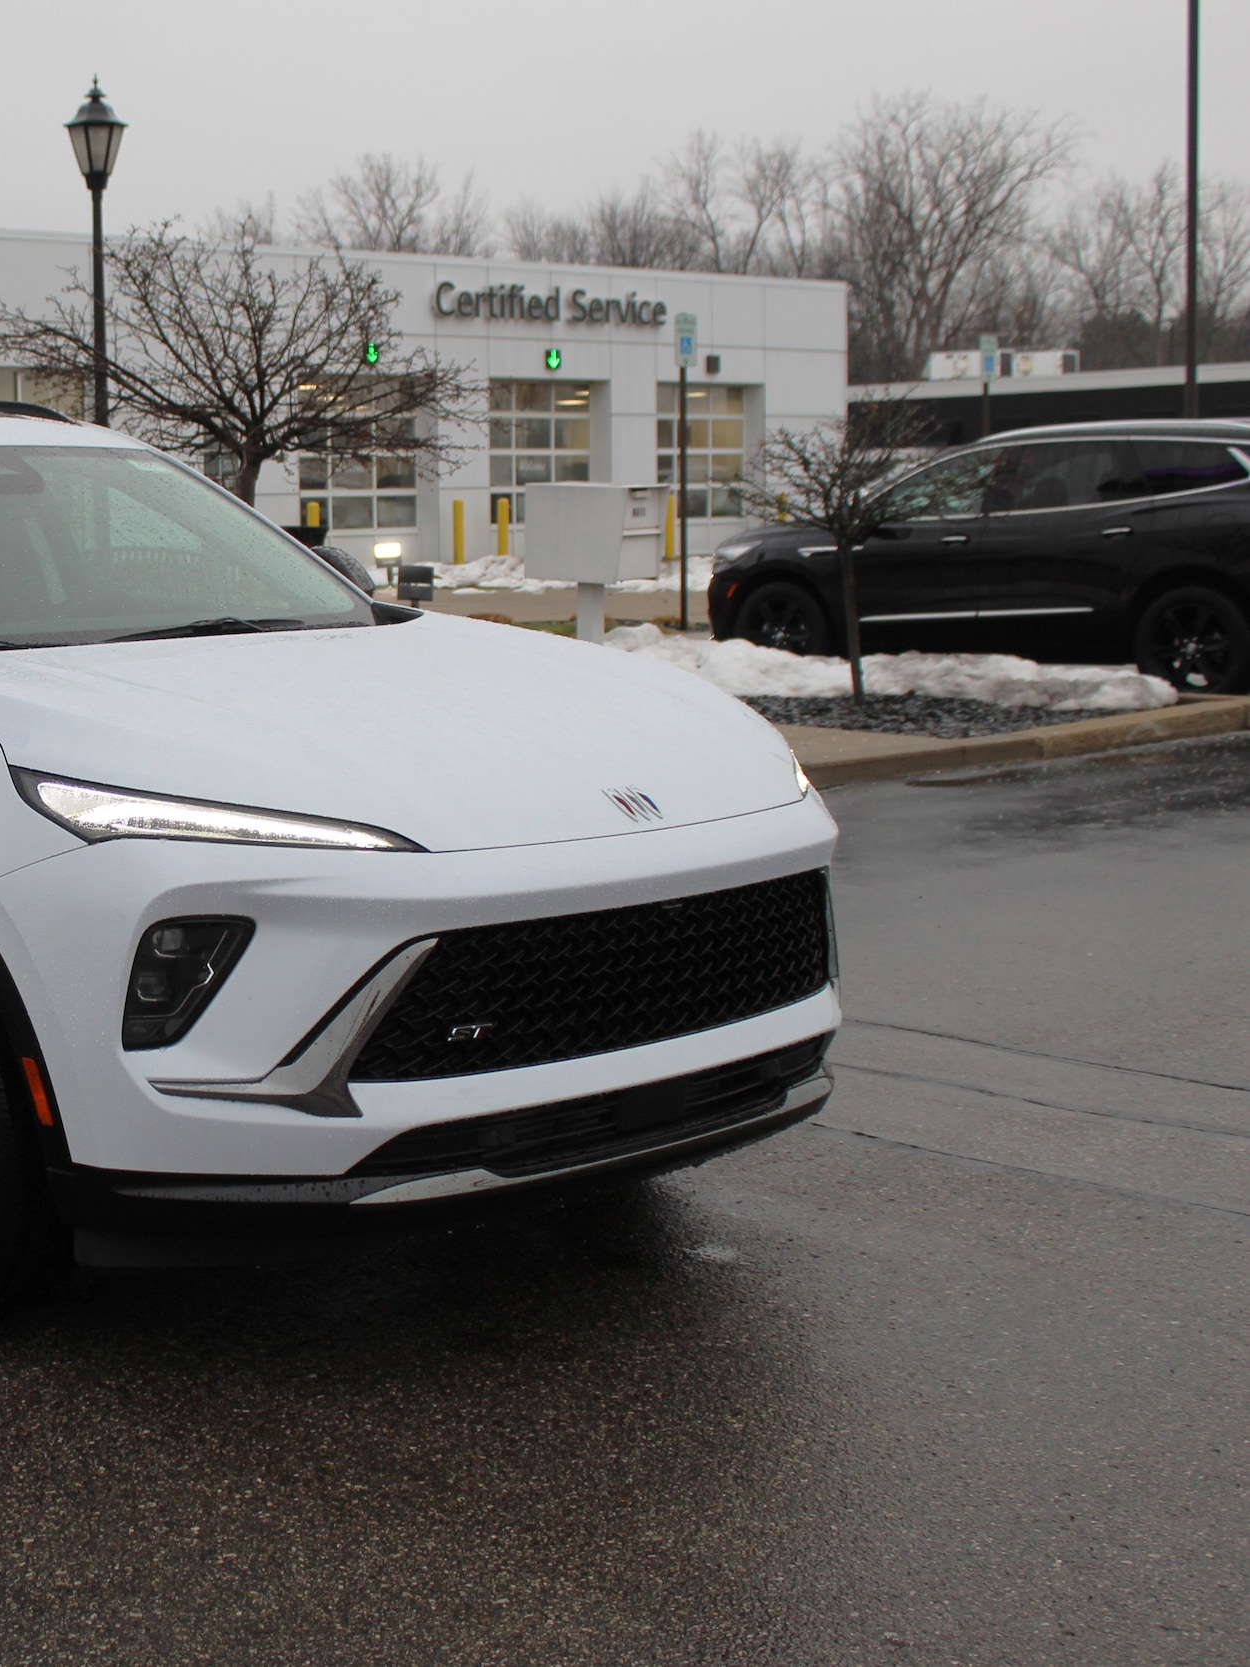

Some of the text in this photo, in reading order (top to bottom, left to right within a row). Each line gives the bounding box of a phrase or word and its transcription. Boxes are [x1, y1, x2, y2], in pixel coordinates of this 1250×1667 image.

[435, 280, 668, 326] Certified Service
[447, 1022, 493, 1042] ST
